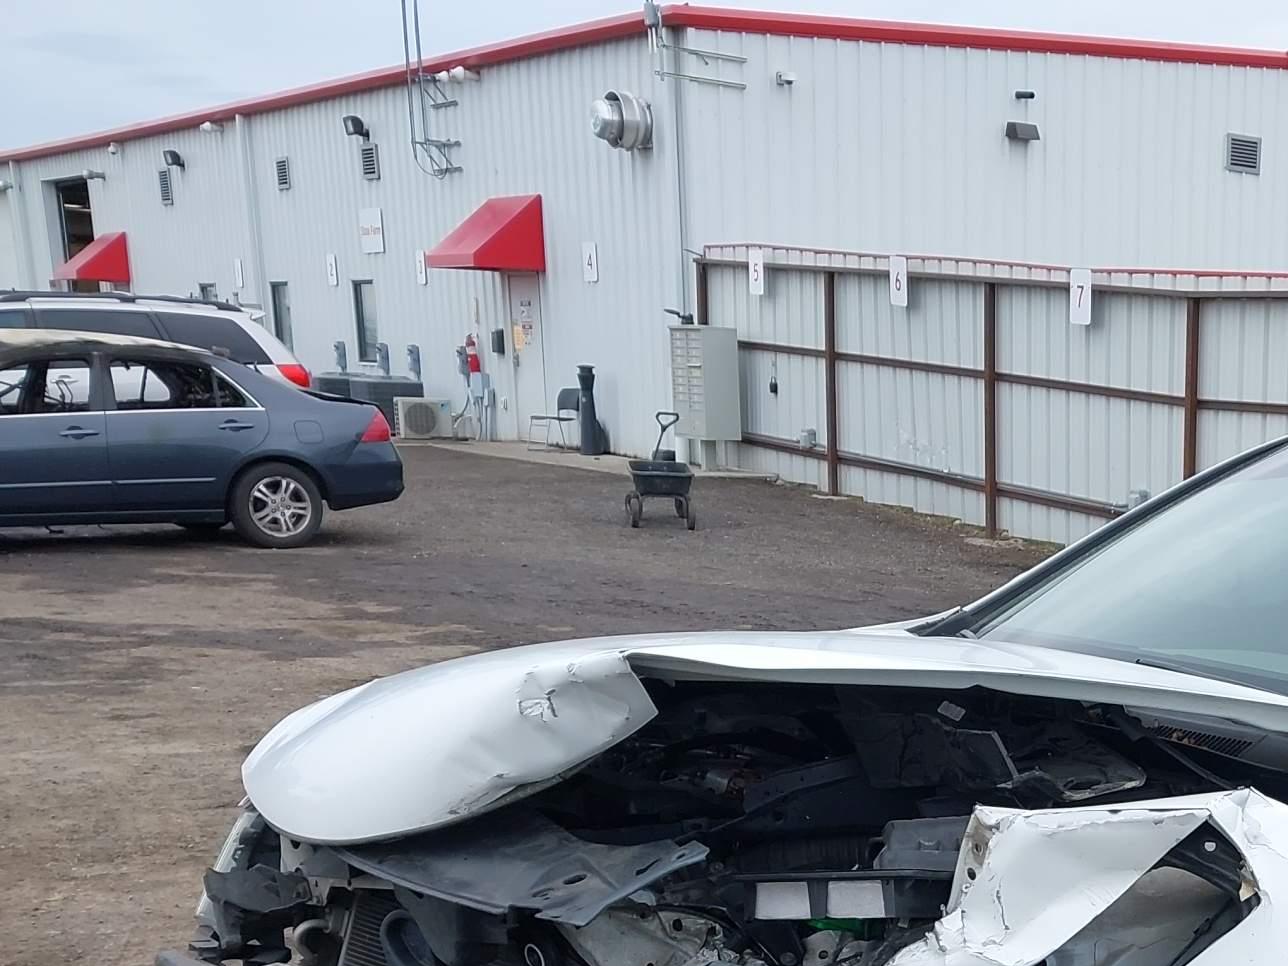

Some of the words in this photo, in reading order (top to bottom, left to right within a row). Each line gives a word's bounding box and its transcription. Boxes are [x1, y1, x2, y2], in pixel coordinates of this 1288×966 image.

[328, 263, 334, 277] 2
[587, 253, 593, 270] 4
[753, 263, 760, 282] 5
[895, 271, 902, 291] 6
[1076, 285, 1084, 308] 7
